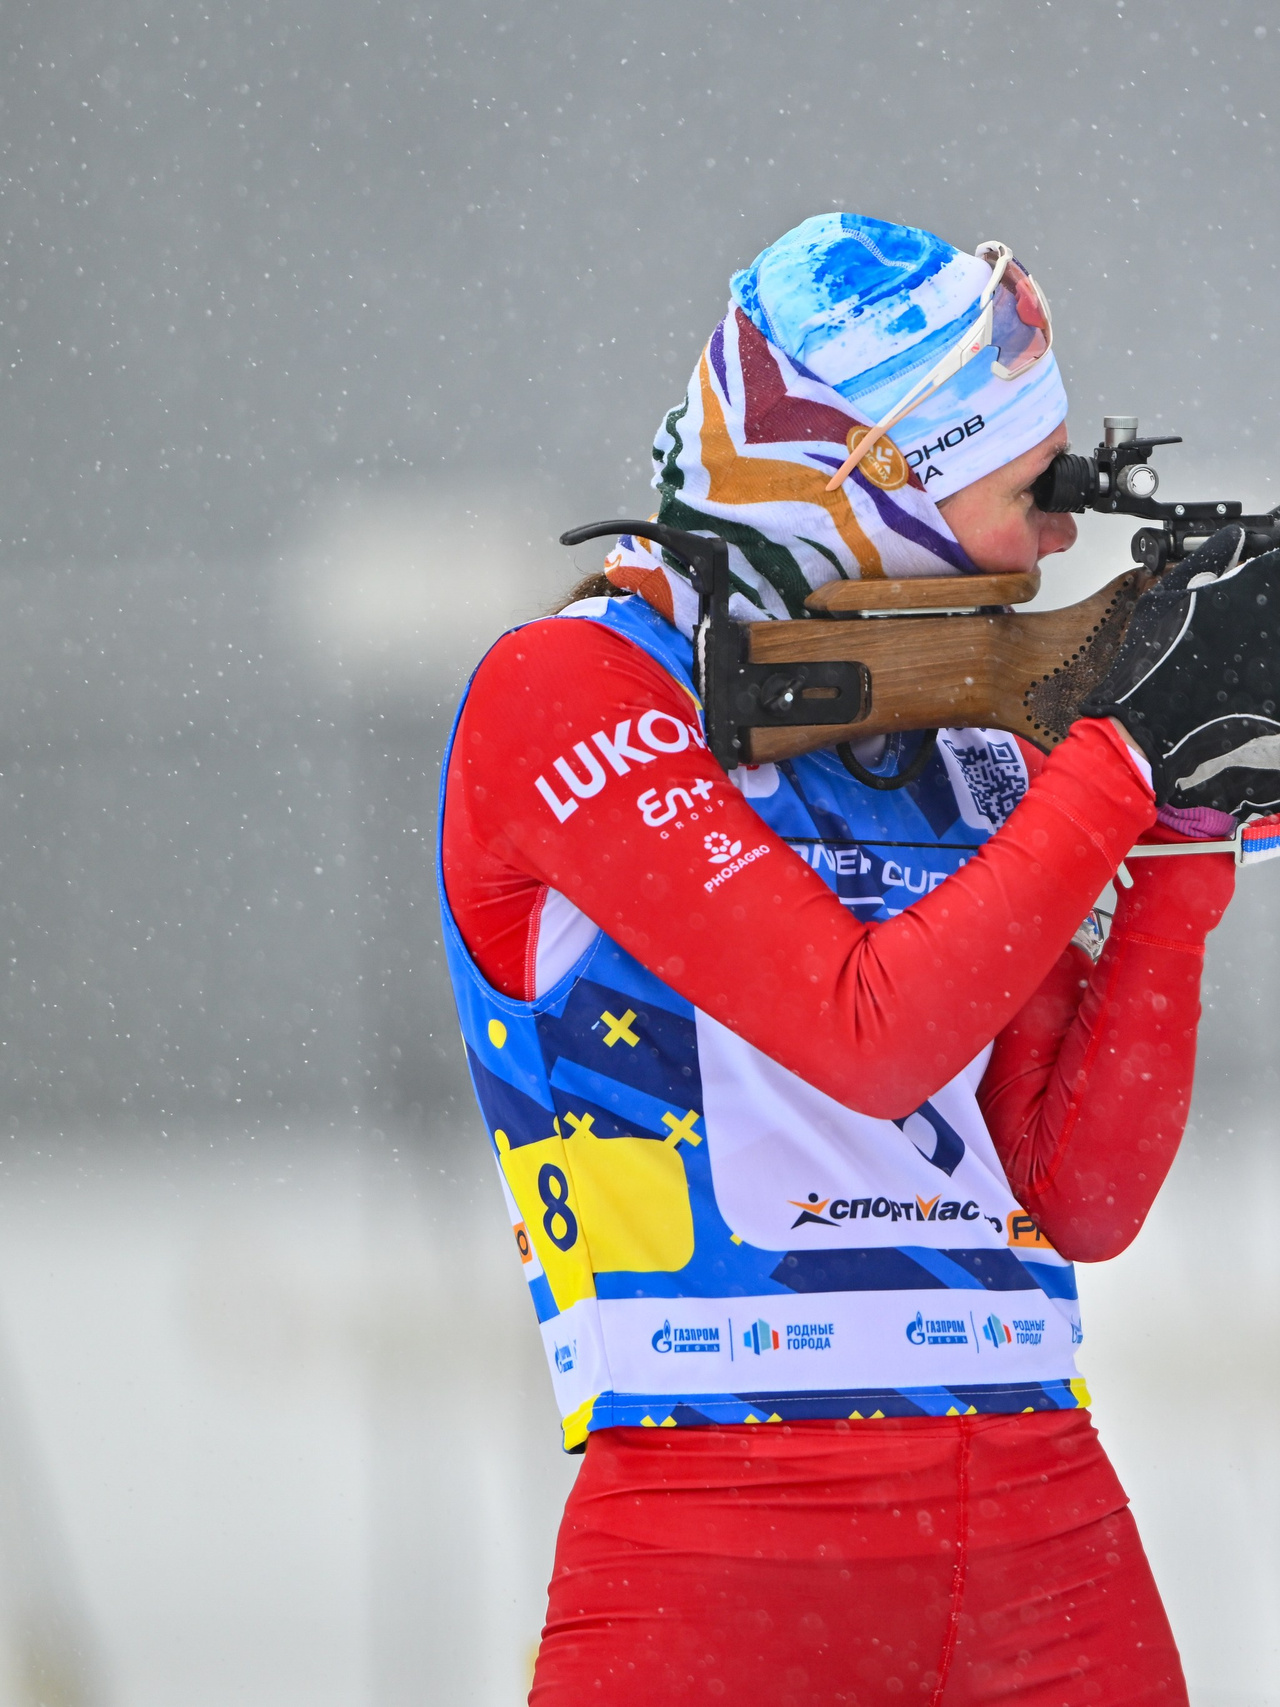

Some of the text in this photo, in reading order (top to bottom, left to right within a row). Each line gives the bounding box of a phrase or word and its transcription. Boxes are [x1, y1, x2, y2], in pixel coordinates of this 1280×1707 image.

[660, 799, 724, 840] GROUP
[703, 844, 771, 893] PHOSAGRO
[538, 1162, 579, 1253] 8
[674, 1323, 835, 1342] ГАЗПРОМ РОДНЫЕ
[925, 1319, 1046, 1334] ГАЗПРОМ РОДНЫЕ
[787, 1337, 832, 1351] ГОРОДА
